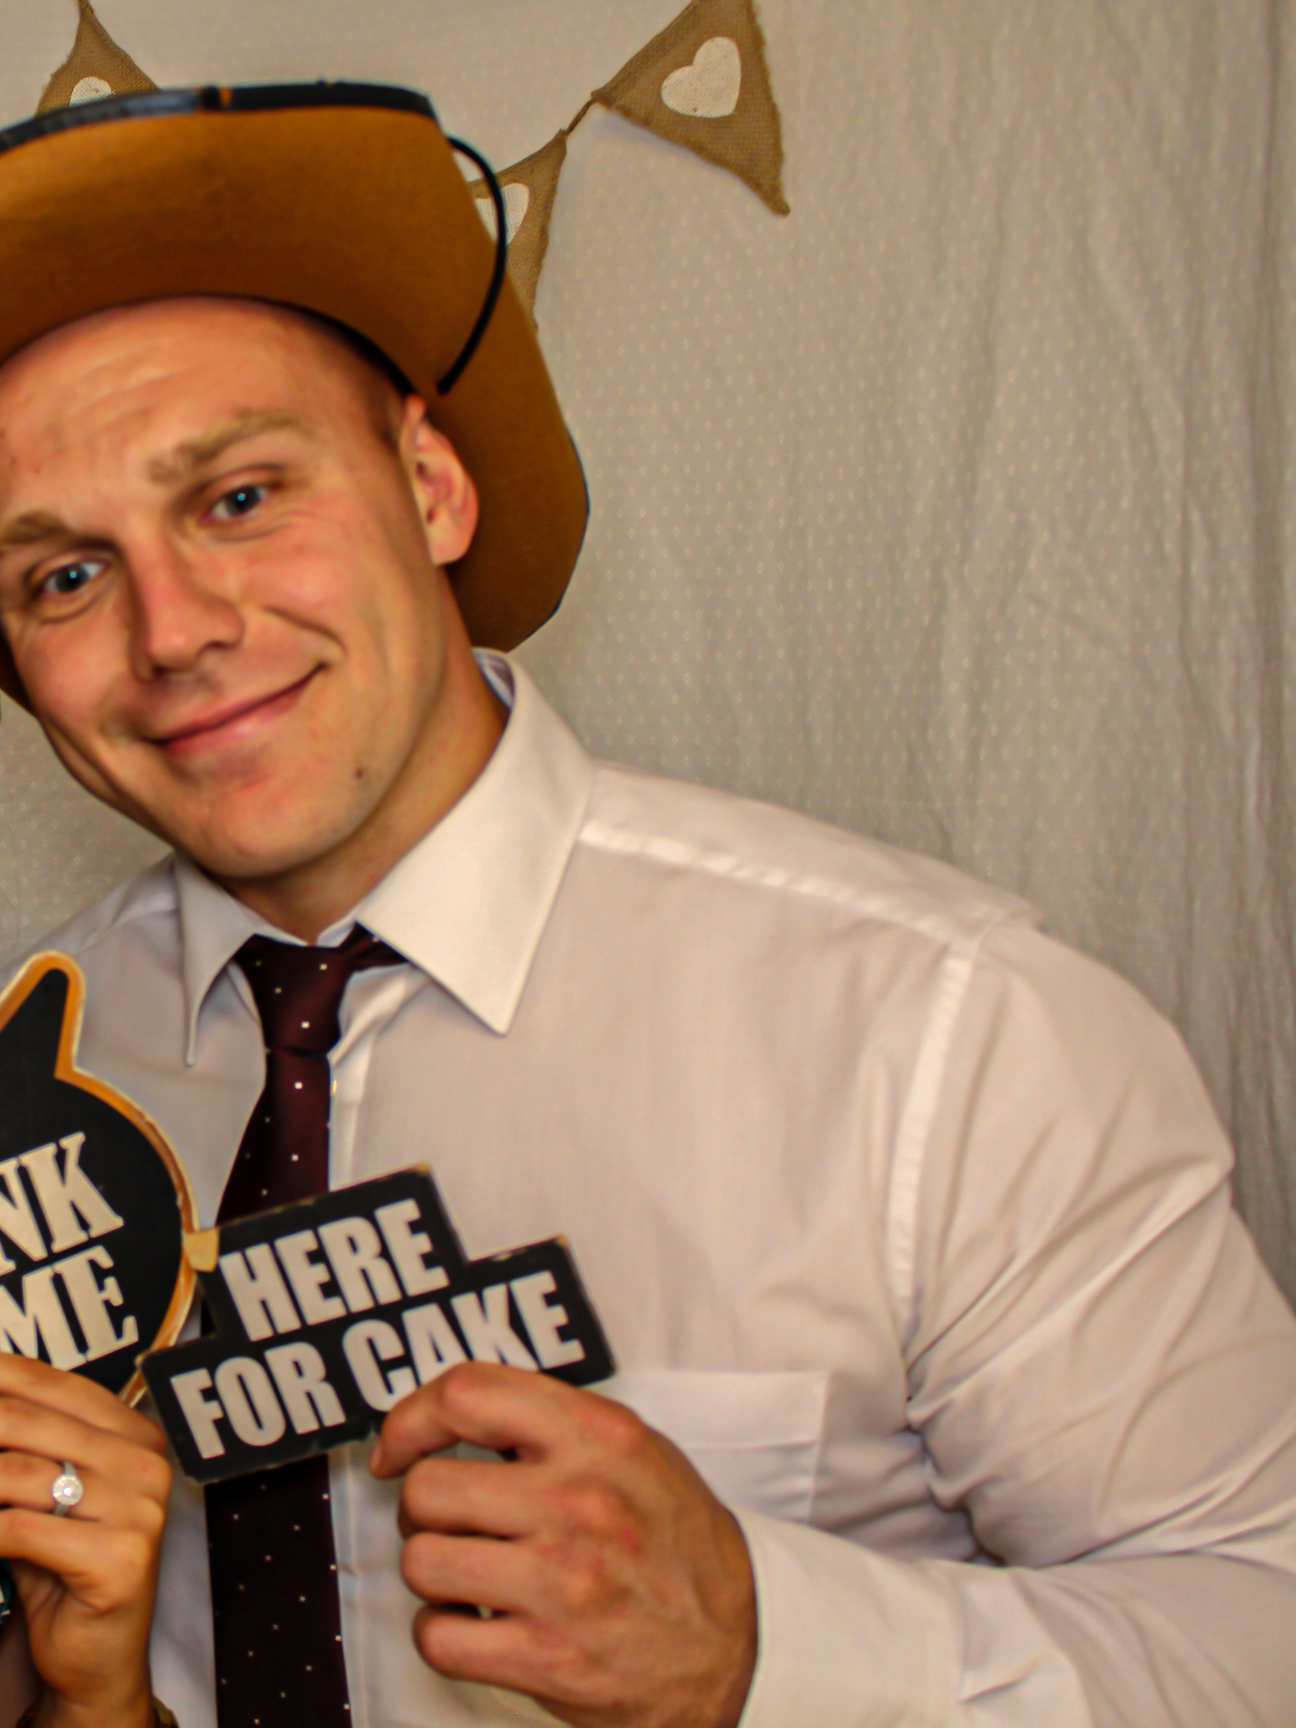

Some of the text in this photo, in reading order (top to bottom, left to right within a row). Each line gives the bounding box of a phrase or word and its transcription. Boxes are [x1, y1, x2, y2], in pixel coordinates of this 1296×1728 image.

[219, 1198, 449, 1342] HERE
[170, 1270, 586, 1459] FOR CAKE
